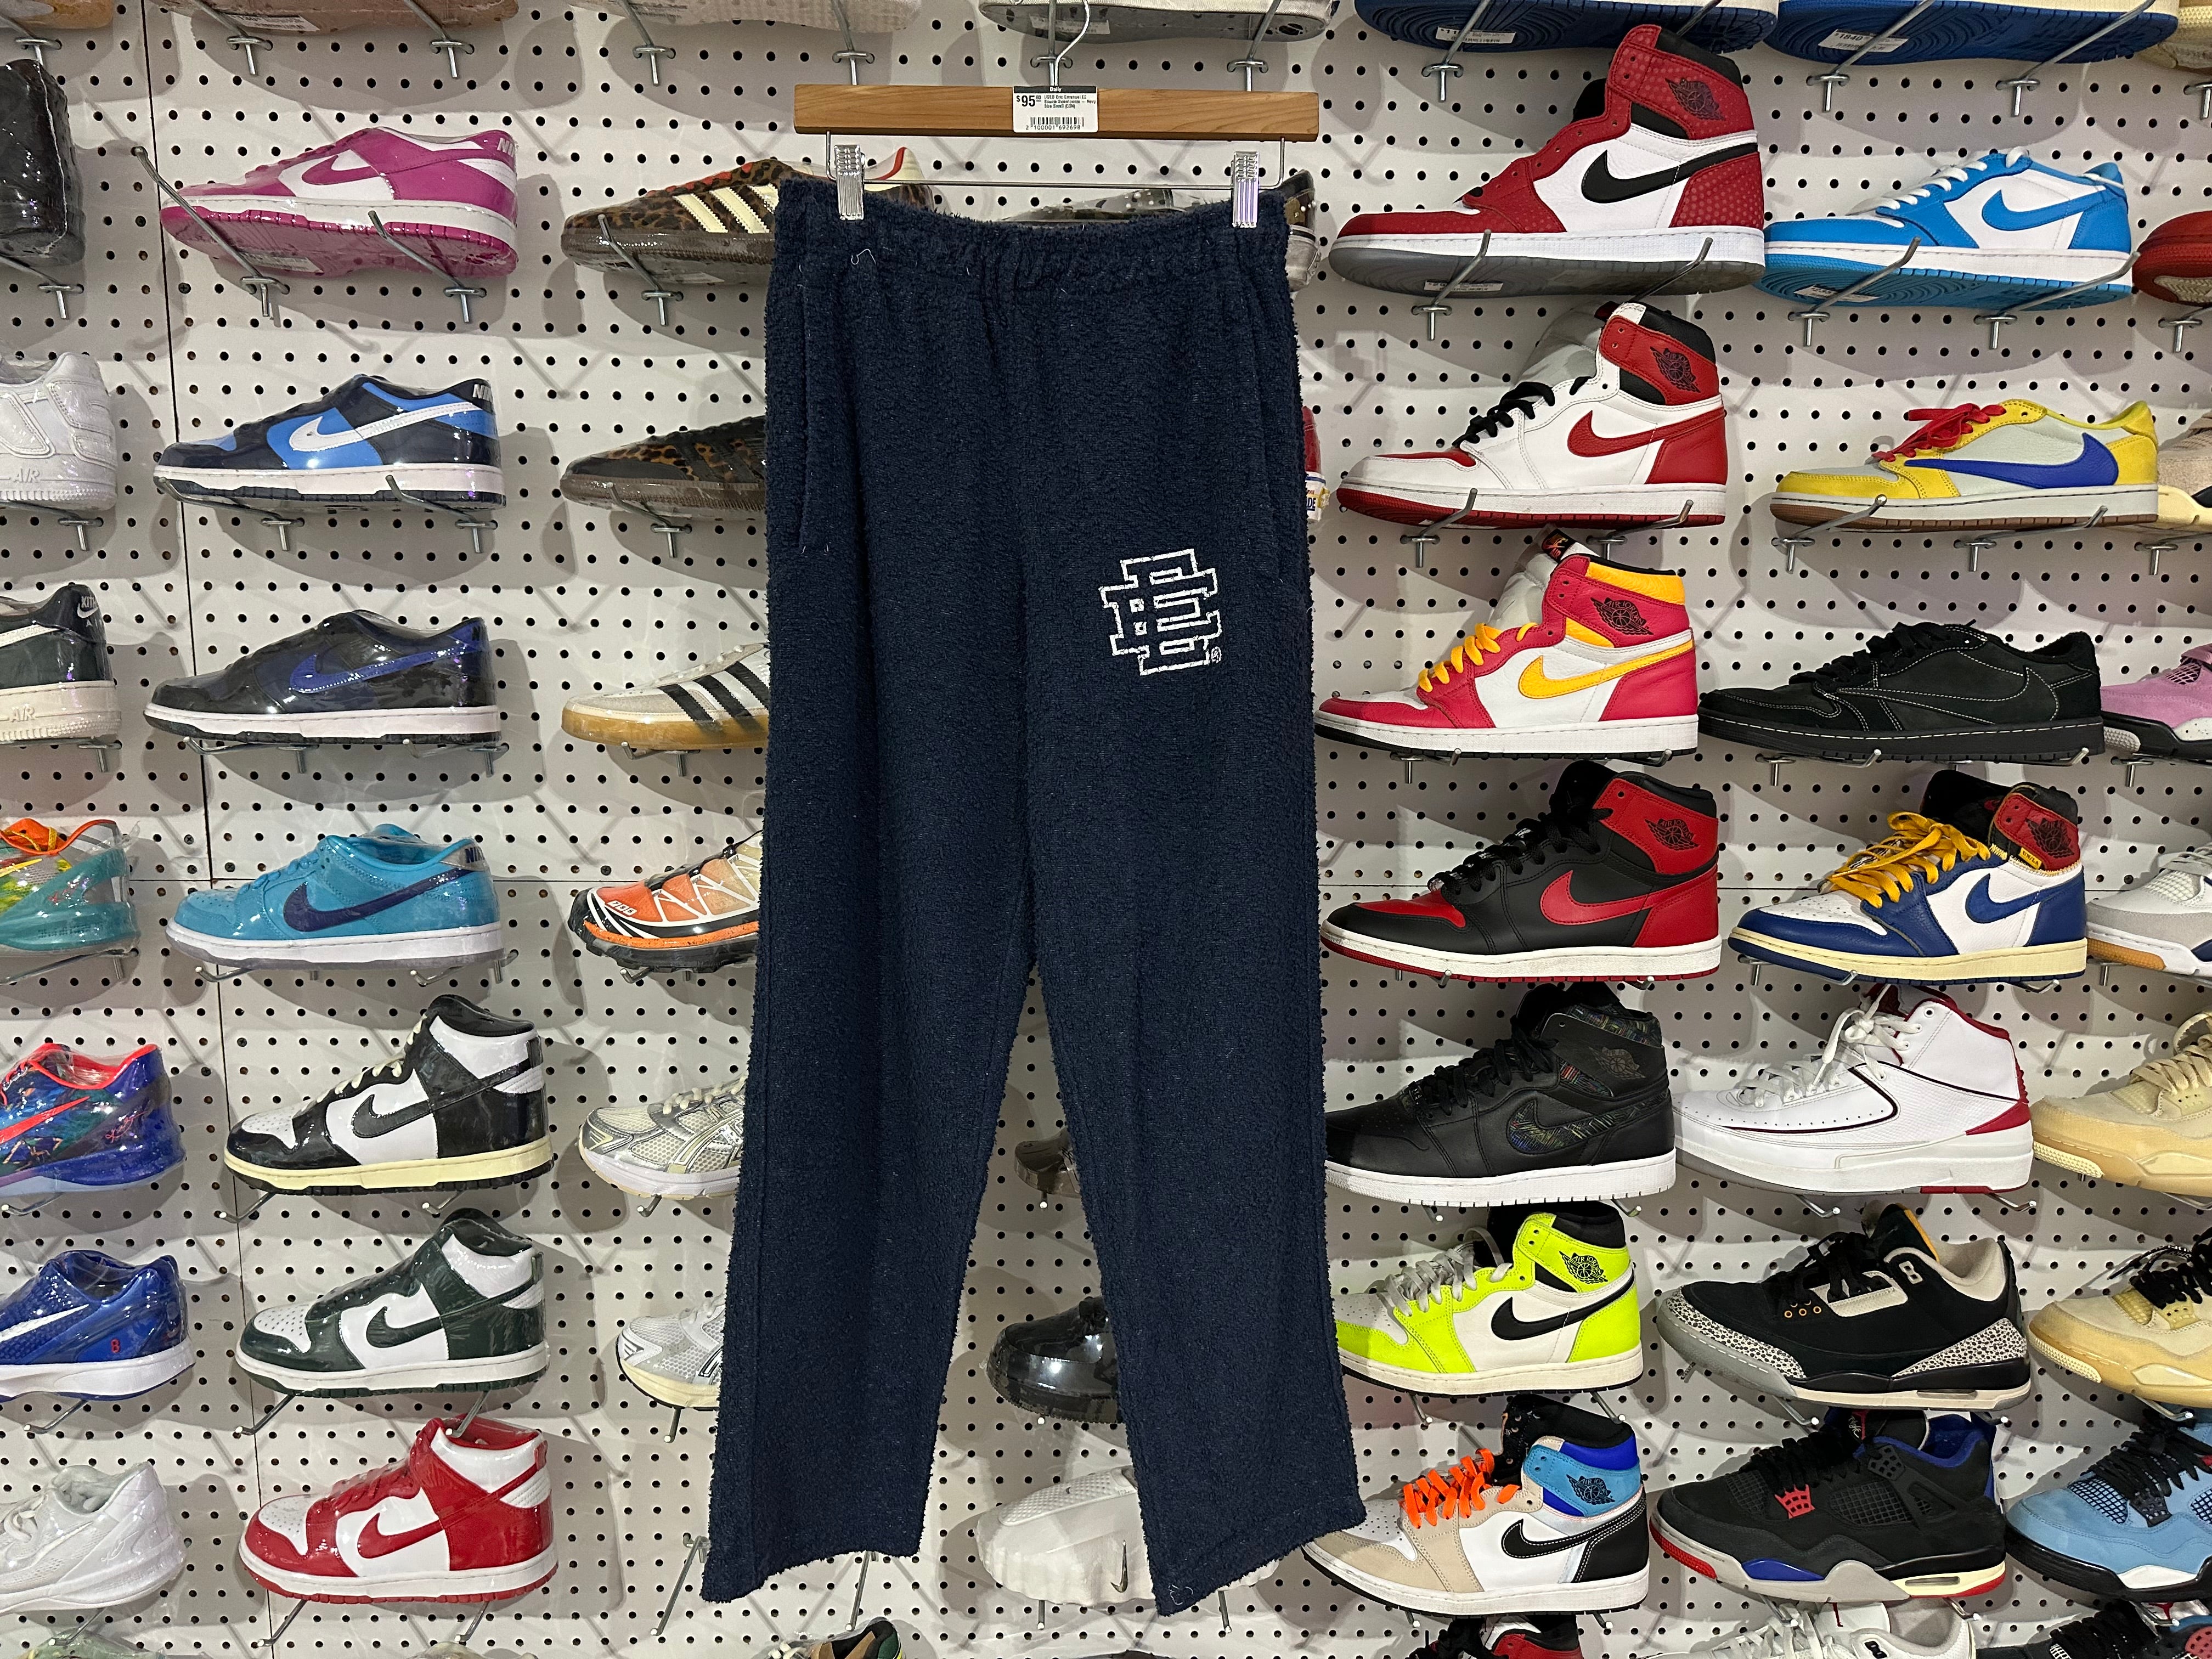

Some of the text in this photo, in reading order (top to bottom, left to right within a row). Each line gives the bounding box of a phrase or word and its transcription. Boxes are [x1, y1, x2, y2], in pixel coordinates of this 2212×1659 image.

[12, 467, 40, 483] AIR
[1605, 600, 1645, 626] AIR JORDAN
[10, 704, 35, 723] AIR
[1673, 820, 1694, 840] JORDAN
[2022, 850, 2039, 866] UN/LA
